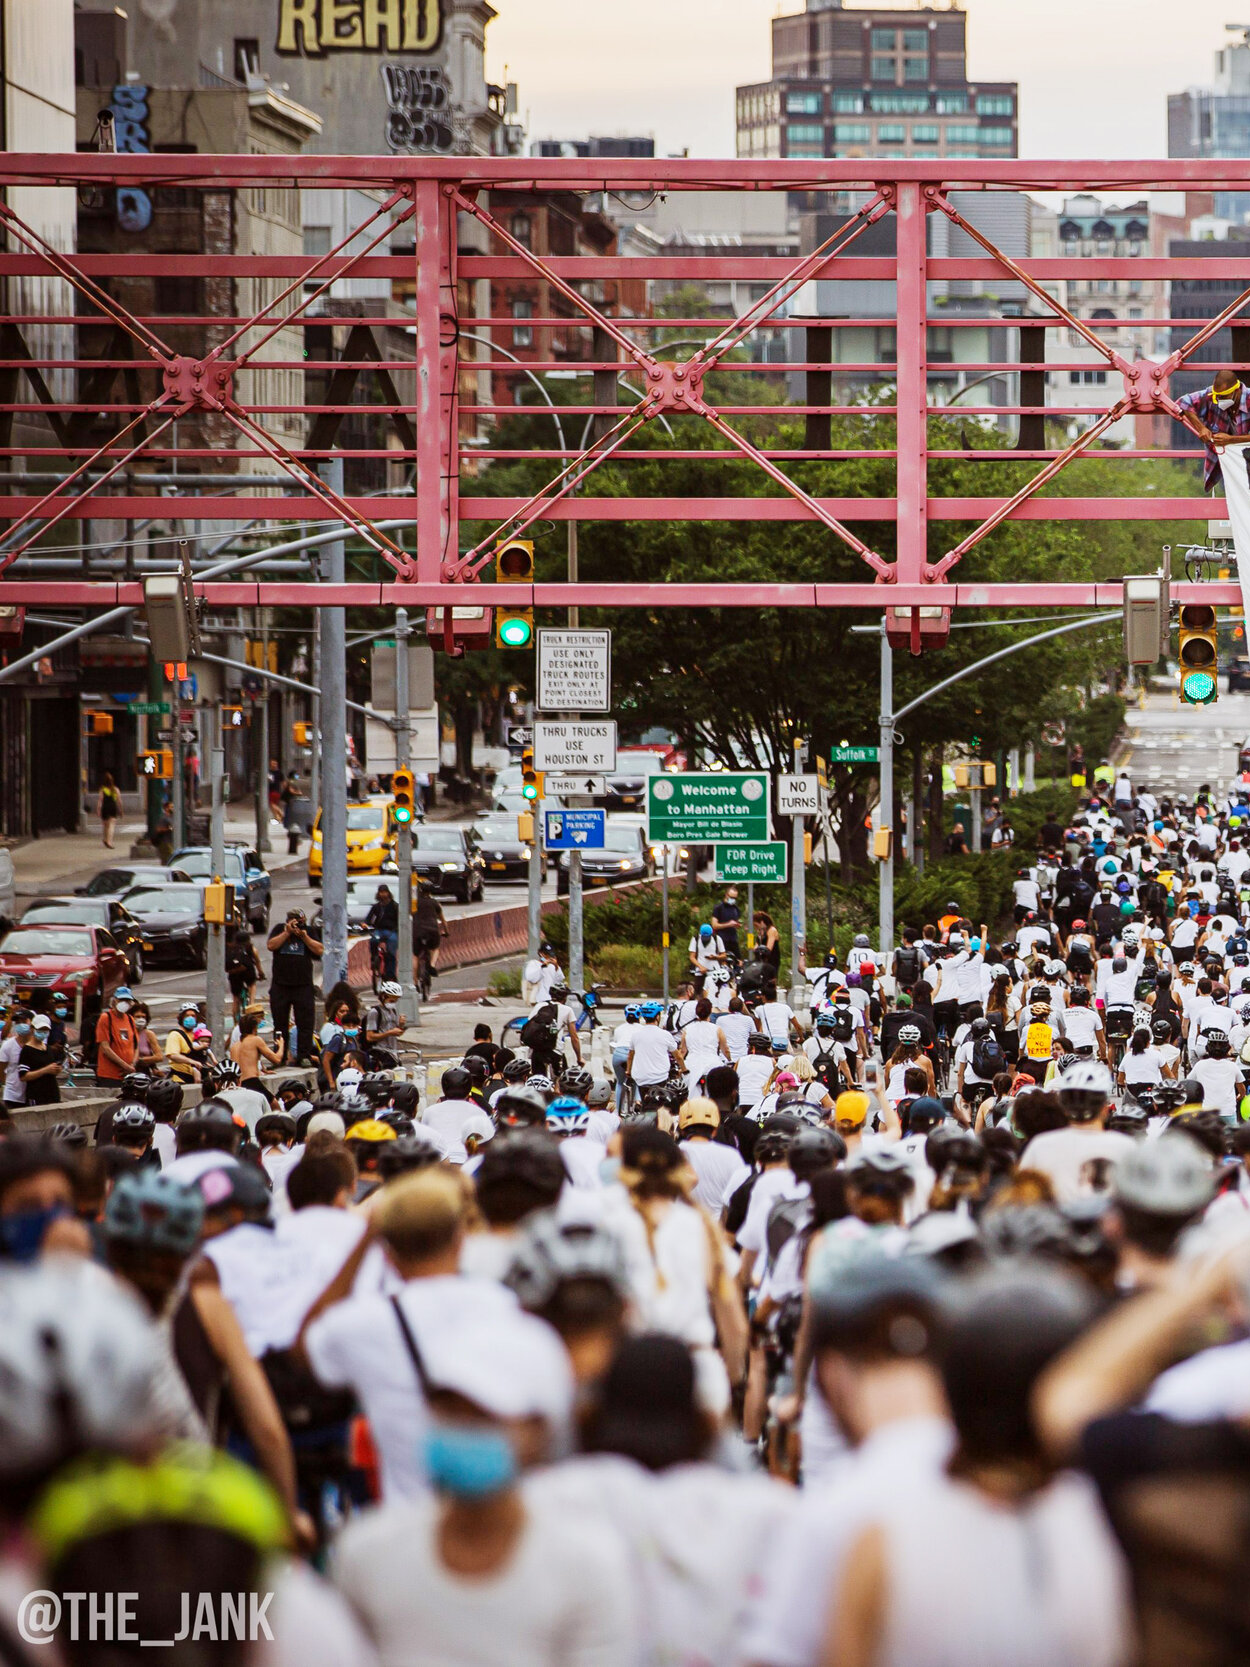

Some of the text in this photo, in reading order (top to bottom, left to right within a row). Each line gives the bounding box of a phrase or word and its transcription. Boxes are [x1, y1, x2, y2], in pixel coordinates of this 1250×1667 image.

[277, 0, 443, 54] READ
[567, 636, 605, 644] RESTRICTION
[574, 650, 594, 658] ONLY
[549, 661, 599, 669] DESIGNATED
[516, 732, 532, 741] ONE
[543, 727, 607, 737] THRU TRUCKS
[566, 742, 584, 751] USE
[836, 749, 866, 760] Suffolk
[545, 755, 604, 764] HOUSTON ST
[552, 782, 576, 790] THRU
[681, 784, 737, 796] Welcome
[790, 781, 806, 792] NO
[781, 798, 816, 808] TURNS
[667, 804, 750, 815] to Manhattan
[565, 813, 602, 821] MUNICIPAL
[565, 822, 596, 830] PARKING
[672, 821, 695, 829] Mayor
[727, 850, 775, 860] FDR Drive
[725, 864, 777, 877] Keep Right
[853, 952, 868, 963] 10
